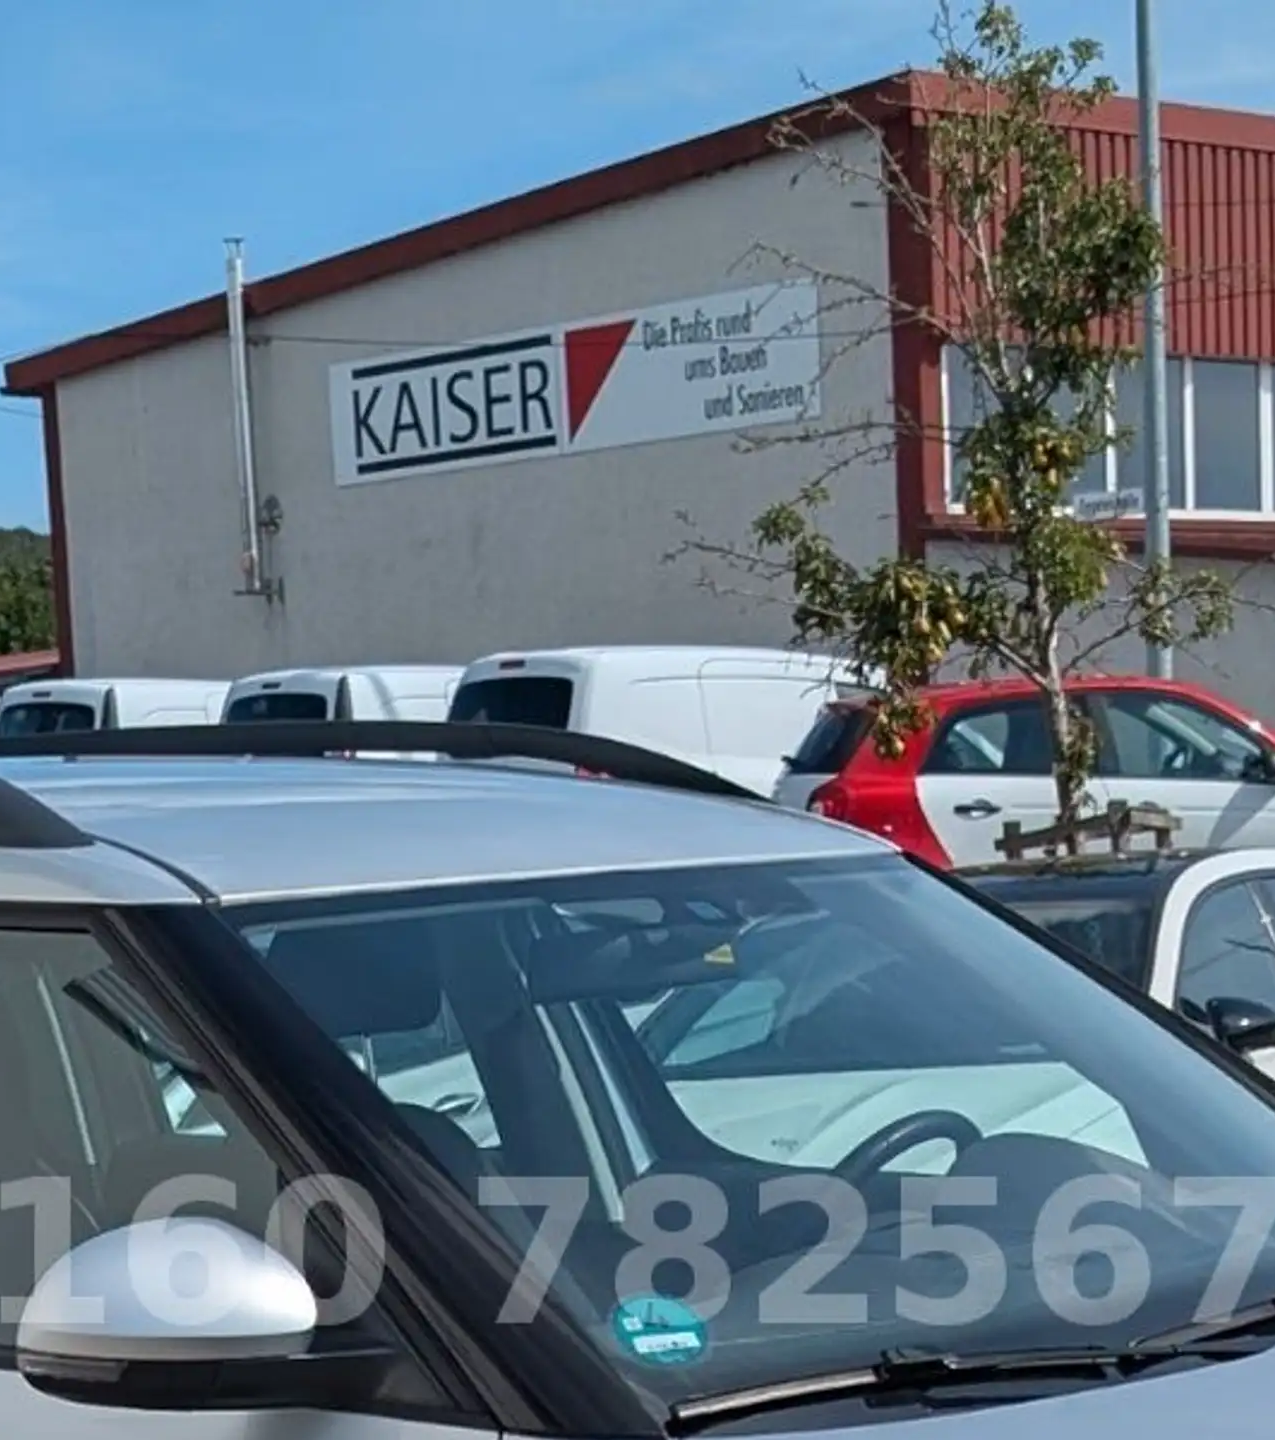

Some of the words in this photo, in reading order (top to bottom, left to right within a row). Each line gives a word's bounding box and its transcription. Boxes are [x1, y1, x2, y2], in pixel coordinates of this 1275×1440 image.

[642, 319, 668, 351] Die
[670, 307, 713, 345] Profis
[715, 299, 753, 337] rund
[684, 357, 716, 382] ums
[718, 345, 768, 376] Bauen
[352, 358, 554, 458] KAISER
[703, 383, 733, 420] und
[736, 382, 805, 416] Sanieren
